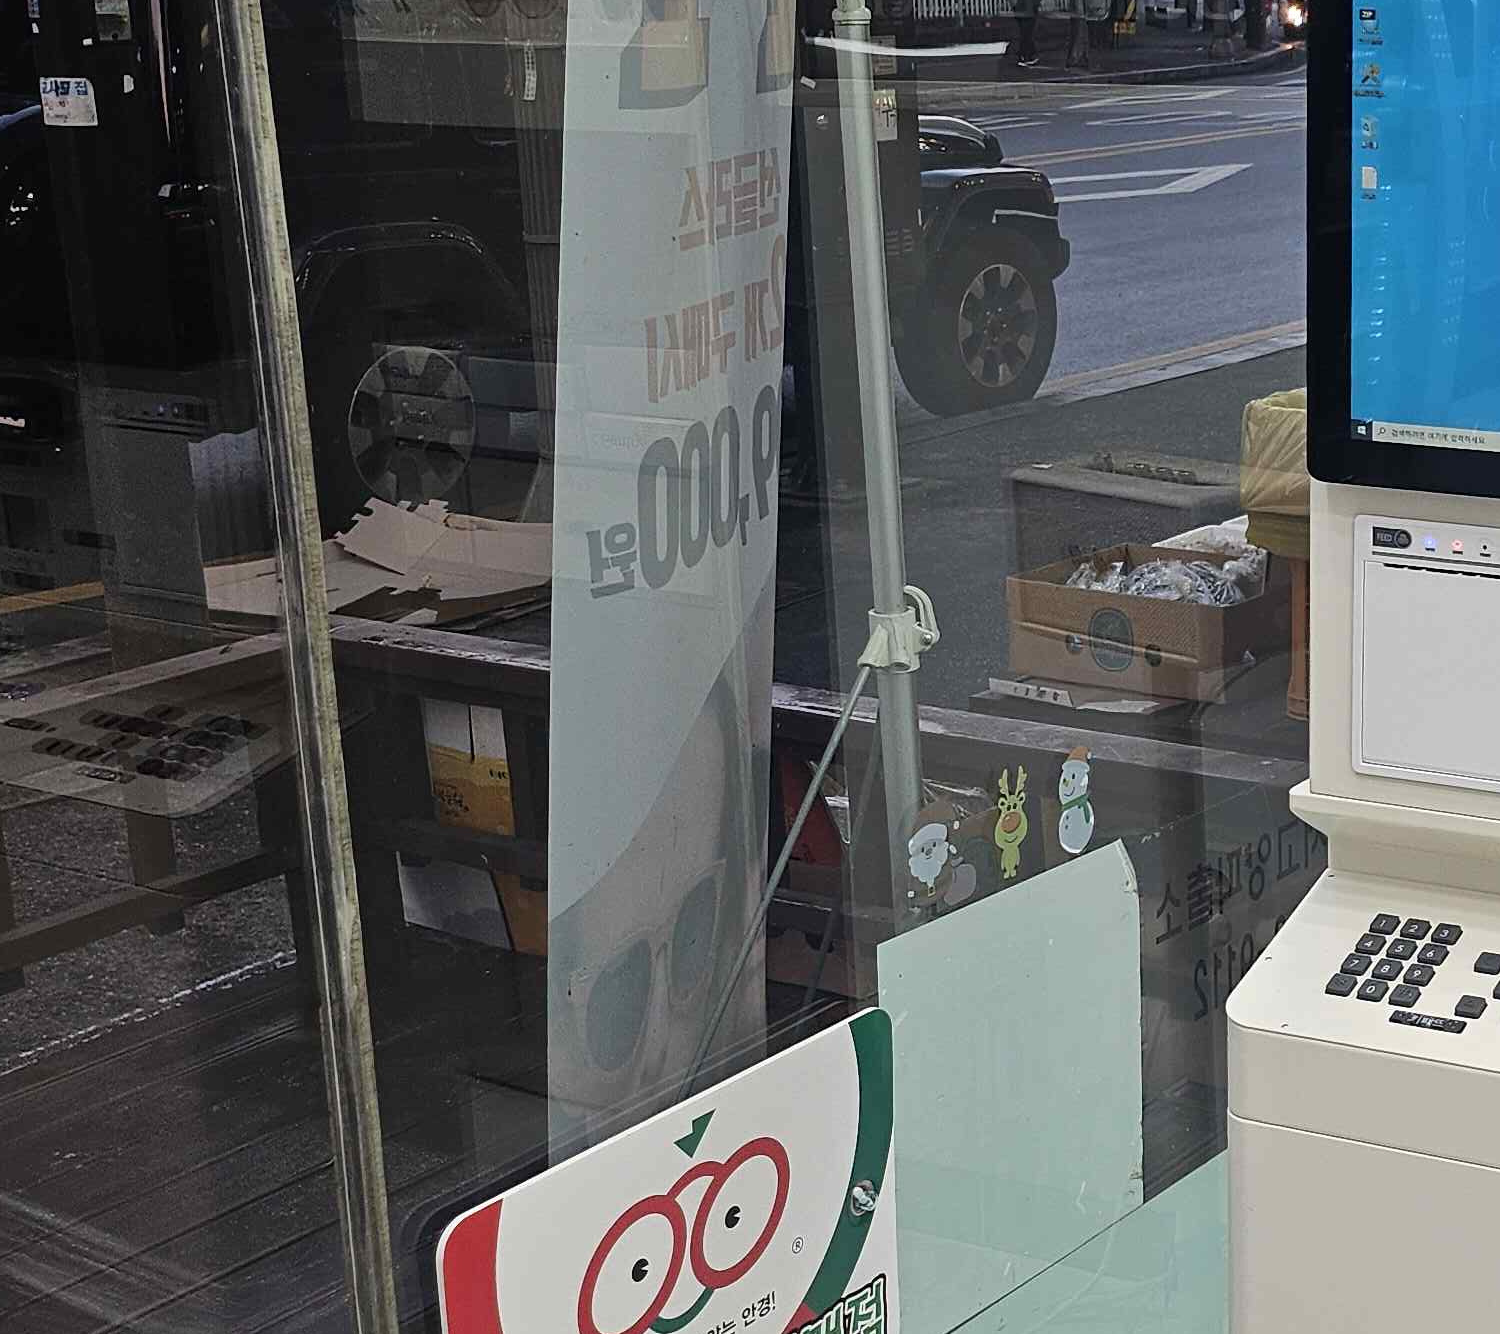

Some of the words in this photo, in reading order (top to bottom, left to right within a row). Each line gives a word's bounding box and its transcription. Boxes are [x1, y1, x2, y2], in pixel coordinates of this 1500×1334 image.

[1379, 919, 1387, 927] 1
[1408, 924, 1419, 933] 2
[1439, 929, 1450, 938] 3
[1363, 939, 1374, 948] 4
[1394, 944, 1404, 953] 5
[1426, 949, 1436, 958] 6
[1350, 959, 1360, 967] 7
[1380, 964, 1391, 973] 8
[1412, 969, 1422, 979] 9
[1366, 985, 1376, 994] 0
[741, 1290, 776, 1327] 안경!
